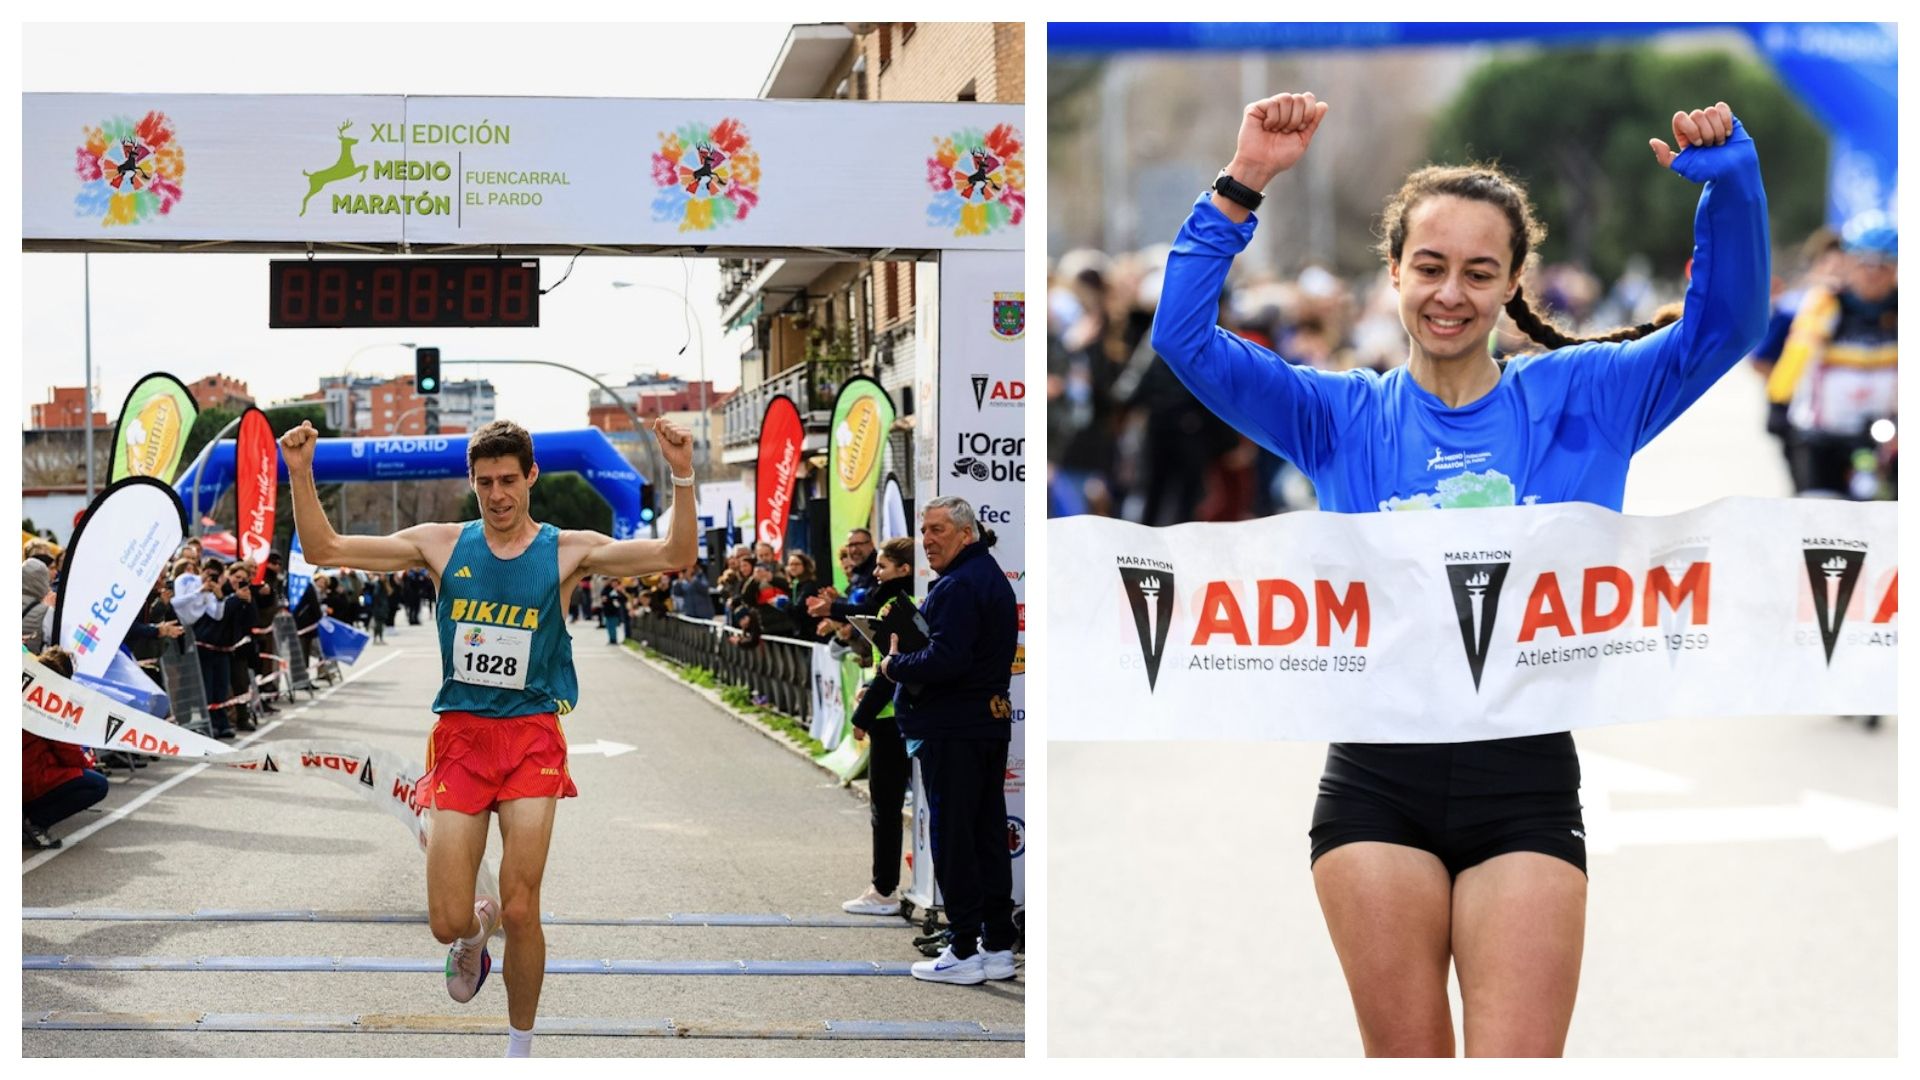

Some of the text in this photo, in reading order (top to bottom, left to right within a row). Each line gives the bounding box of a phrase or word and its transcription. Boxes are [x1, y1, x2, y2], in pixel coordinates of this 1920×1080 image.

[370, 118, 511, 145] XLI EDICIÓN
[373, 159, 451, 182] MEDIO
[464, 170, 571, 186] FUENCARRAL
[331, 190, 451, 217] MARATÓN
[464, 192, 543, 207] EL PARDO
[374, 439, 449, 454] MADRID
[597, 469, 637, 481] MADRID
[979, 504, 1011, 524] fec
[1801, 537, 1870, 549] MARATHON
[1116, 555, 1174, 571] MARATHON
[1443, 550, 1512, 562] MARATHON
[91, 583, 126, 625] fec
[450, 598, 540, 629] BIKILA
[1191, 579, 1371, 648] ADM
[1517, 561, 1711, 643] ADM
[1515, 632, 1710, 668] Atletismo desde 1959
[464, 651, 518, 677] 1828
[1188, 653, 1367, 672] Atletismo desde 1959
[26, 685, 85, 725] ADM
[120, 727, 181, 756] ADM
[301, 755, 359, 775] ADM
